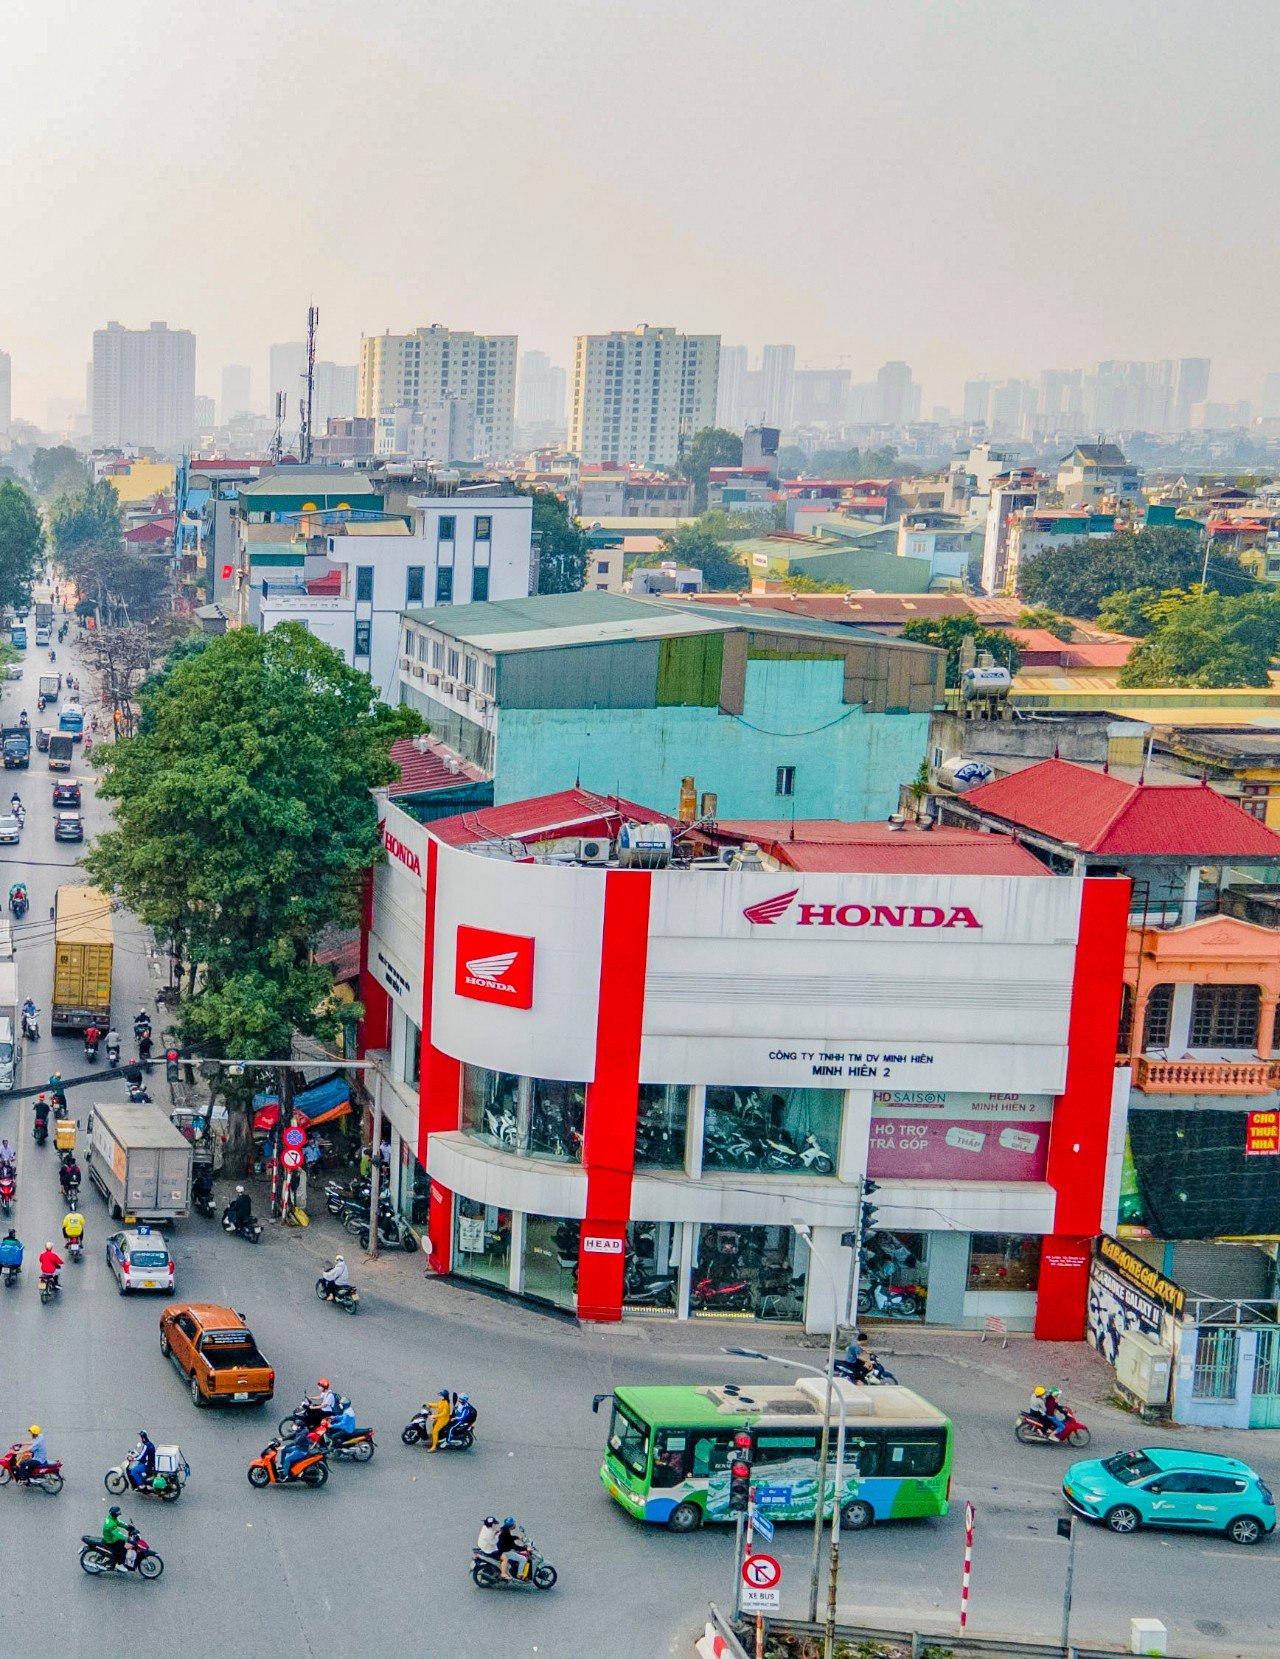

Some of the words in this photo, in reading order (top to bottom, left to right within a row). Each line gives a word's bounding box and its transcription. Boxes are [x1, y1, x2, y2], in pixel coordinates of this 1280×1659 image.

[385, 831, 422, 878] HONDA
[797, 904, 984, 929] HONDA
[465, 975, 518, 994] HONDA
[769, 1050, 797, 1061] CÔNG
[801, 1053, 815, 1061] TY
[819, 1053, 845, 1062] TNHH
[848, 1053, 863, 1062] TM
[866, 1054, 880, 1063] DV
[883, 1054, 908, 1063] MINH
[812, 1065, 843, 1077] MINH
[883, 1067, 891, 1078] 2
[873, 1092, 892, 1102] HD
[894, 1093, 946, 1103] SAISON
[989, 1093, 1019, 1101] HEAD
[972, 1103, 998, 1112] MINH
[1029, 1104, 1036, 1112] 2
[1253, 1113, 1276, 1124] CHO
[1250, 1125, 1278, 1137] THUÊ
[1251, 1137, 1275, 1150] NHÀ
[586, 1240, 620, 1248] HEAD
[760, 1592, 775, 1600] BUS
